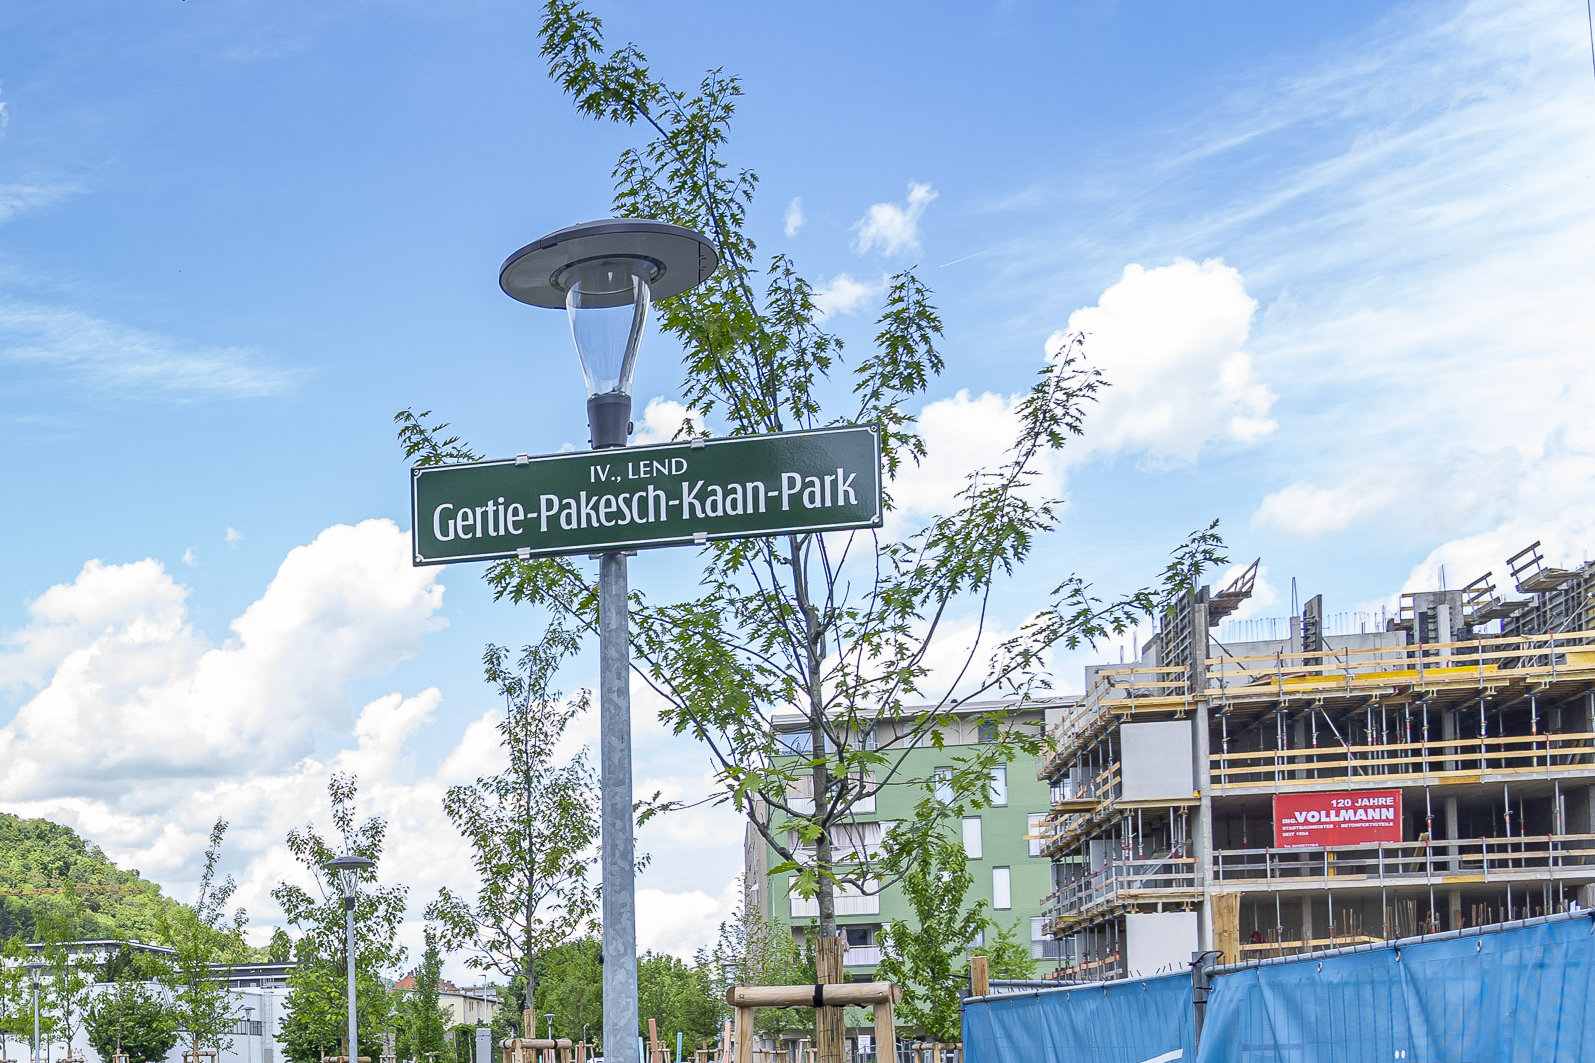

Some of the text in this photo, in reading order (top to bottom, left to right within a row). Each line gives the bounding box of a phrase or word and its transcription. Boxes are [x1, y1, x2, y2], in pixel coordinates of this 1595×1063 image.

[589, 457, 689, 484] IV., LEND
[432, 467, 859, 542] Gertie-Pakesch-Kaan-Park
[1330, 797, 1394, 808] 120 JAHRE
[1294, 808, 1395, 823] VOLLMANN
